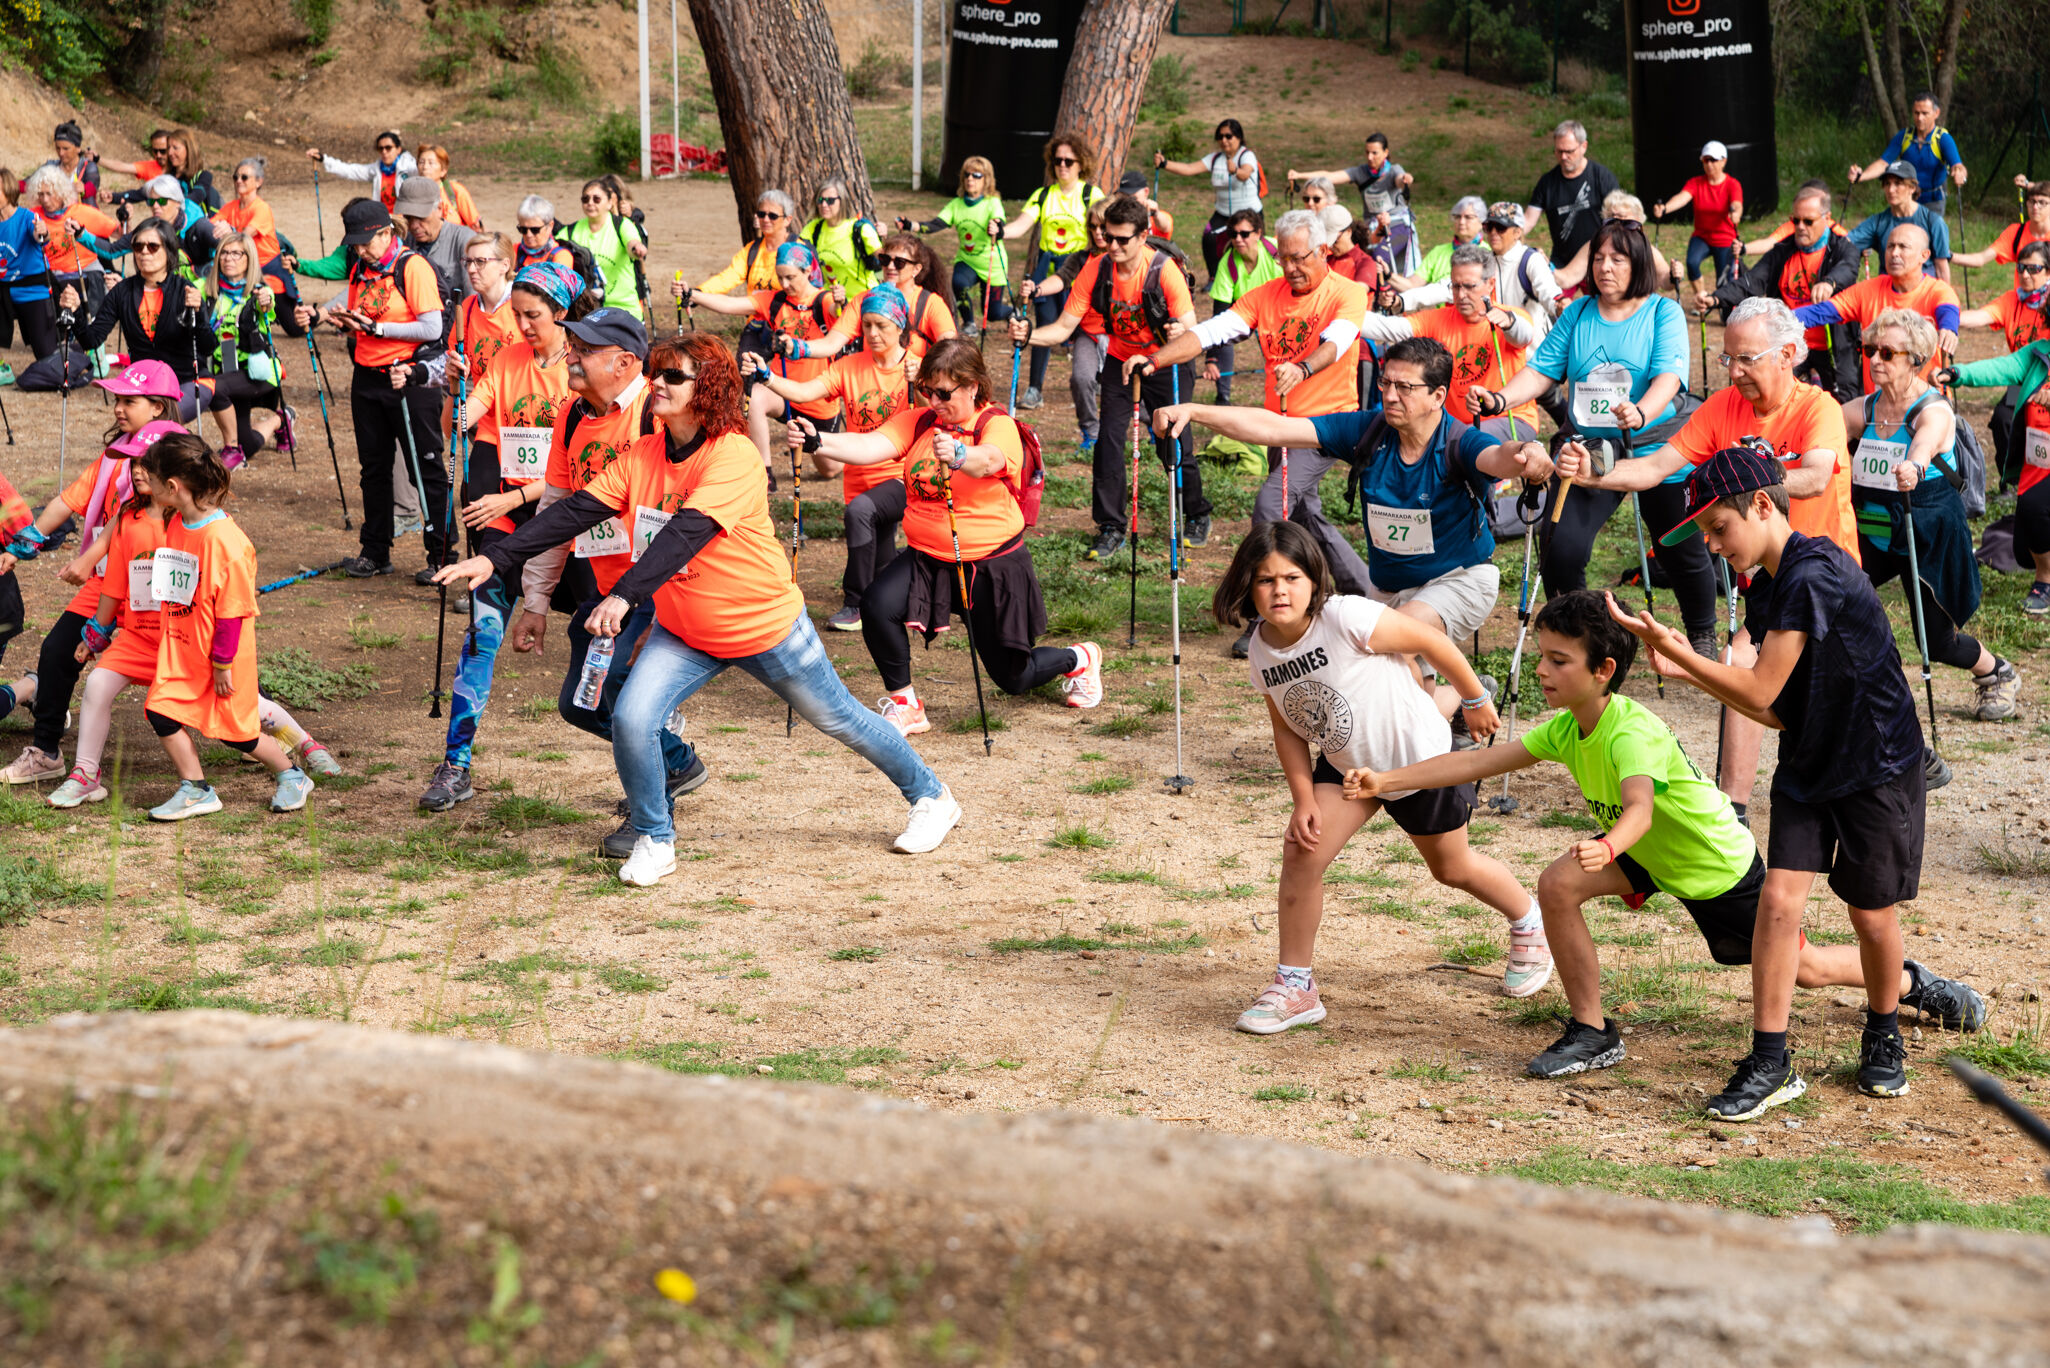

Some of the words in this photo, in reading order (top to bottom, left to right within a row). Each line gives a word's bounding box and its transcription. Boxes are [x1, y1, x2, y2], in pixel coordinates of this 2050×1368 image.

[961, 4, 1041, 27] sphere_pro
[953, 28, 1059, 49] www.sphere-pro.com
[1642, 18, 1732, 39] sphere_pro
[1634, 43, 1752, 63] www.sphere-pro.com
[1590, 399, 1609, 414] 82
[517, 446, 538, 464] 93
[2035, 444, 2047, 459] 69
[1862, 457, 1889, 475] 100
[588, 520, 616, 541] 133
[1387, 524, 1411, 542] 27
[169, 568, 191, 590] 137
[1262, 647, 1328, 688] RAMONES
[1286, 683, 1323, 703] JOHNNY
[1328, 693, 1350, 717] JOEY
